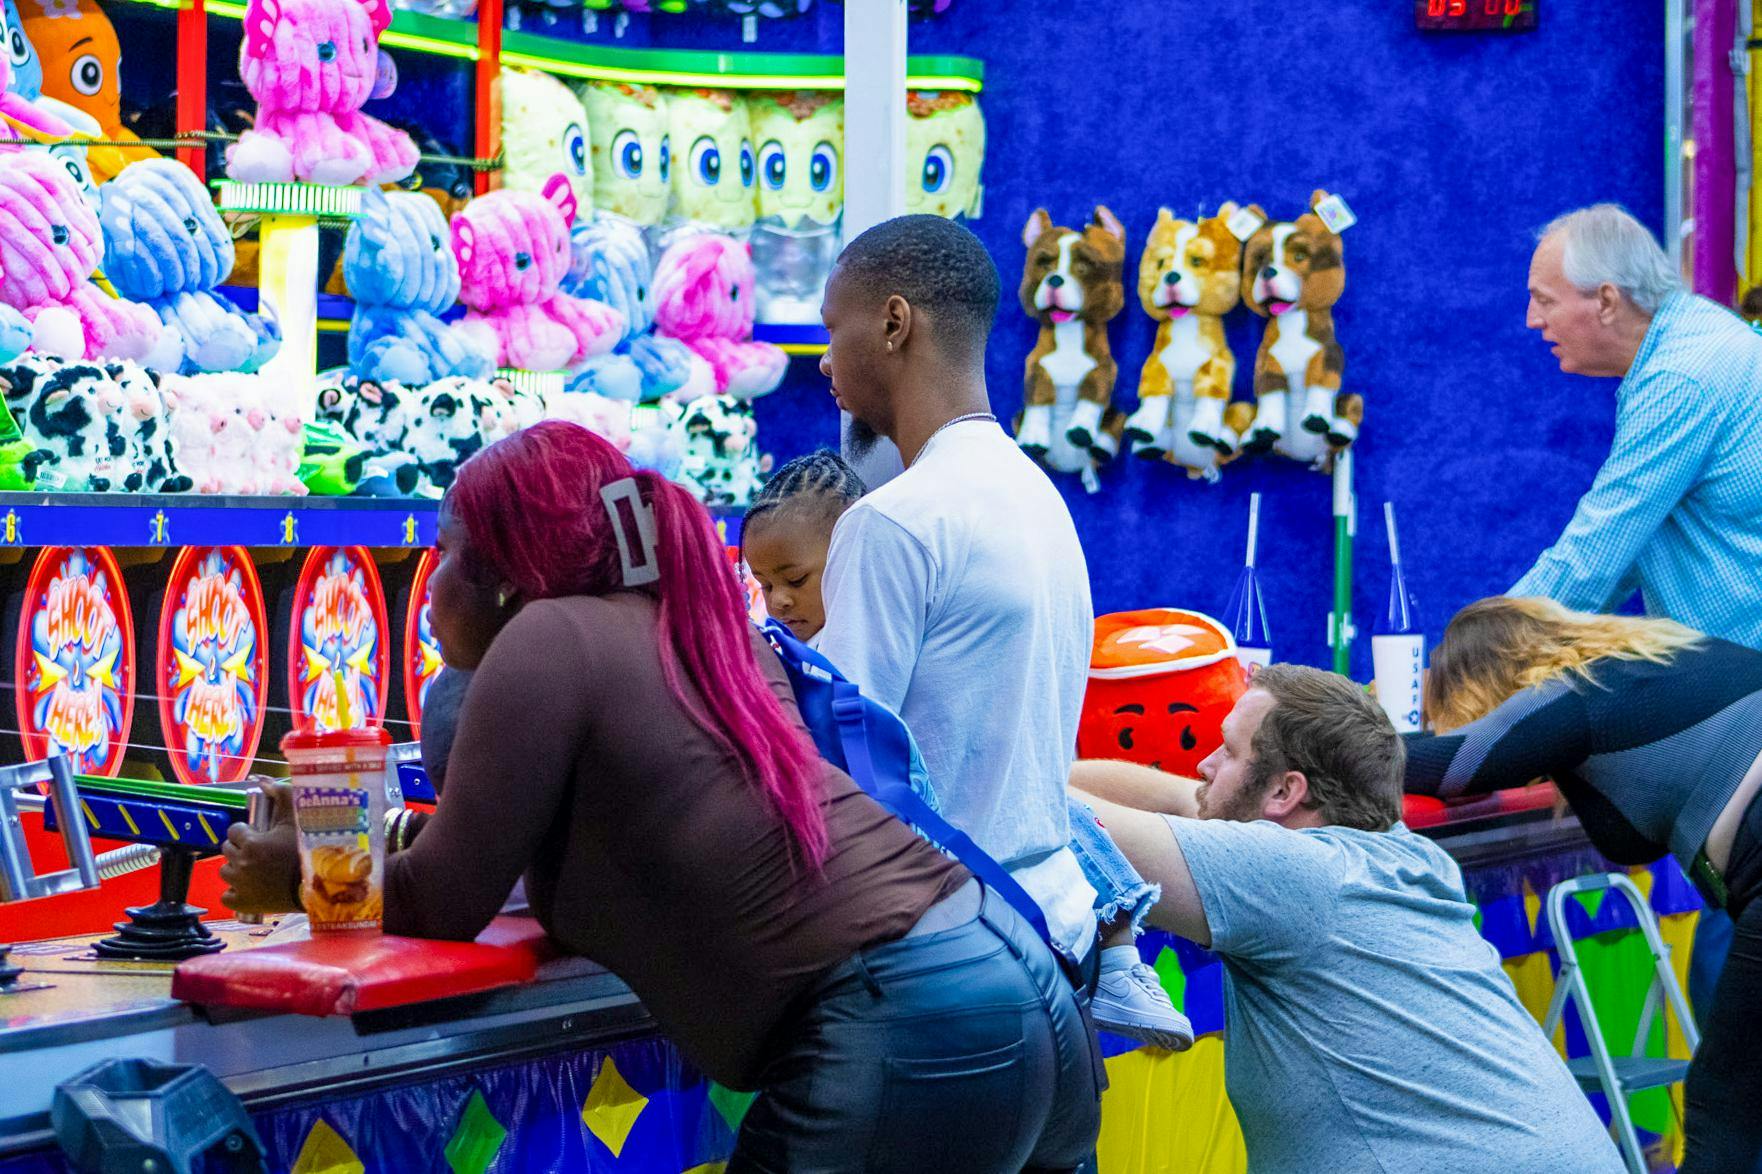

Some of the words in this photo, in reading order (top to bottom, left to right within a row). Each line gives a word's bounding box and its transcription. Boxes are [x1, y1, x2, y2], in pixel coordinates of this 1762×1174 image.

[6, 512, 16, 543] 6
[156, 513, 164, 542] 7
[285, 515, 294, 543] 8
[406, 517, 415, 544] 9
[47, 575, 116, 662] SHOOT
[185, 572, 251, 657] SHOOT
[314, 572, 372, 654] SHOOT
